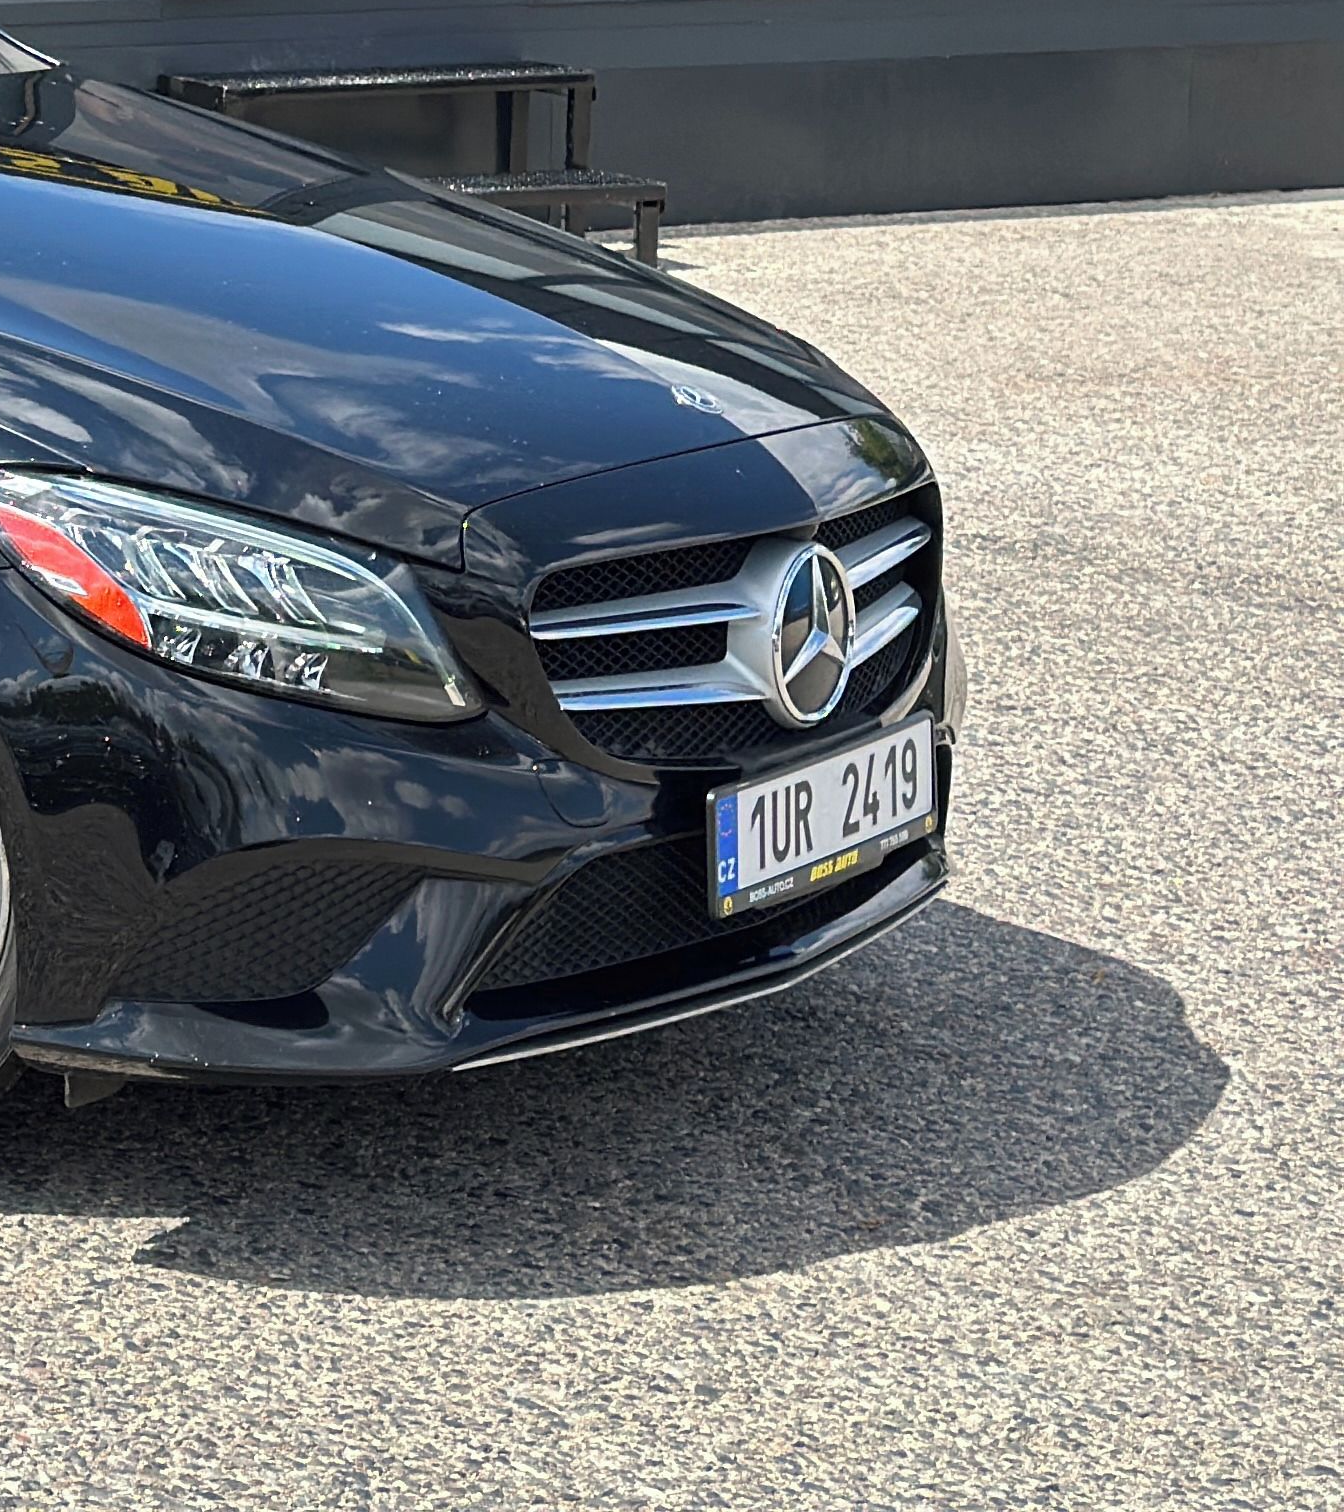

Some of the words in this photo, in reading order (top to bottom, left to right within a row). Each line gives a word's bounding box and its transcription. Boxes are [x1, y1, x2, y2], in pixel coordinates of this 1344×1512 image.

[750, 779, 814, 870] 1UR
[841, 737, 918, 838] 2419
[717, 856, 736, 884] CZ
